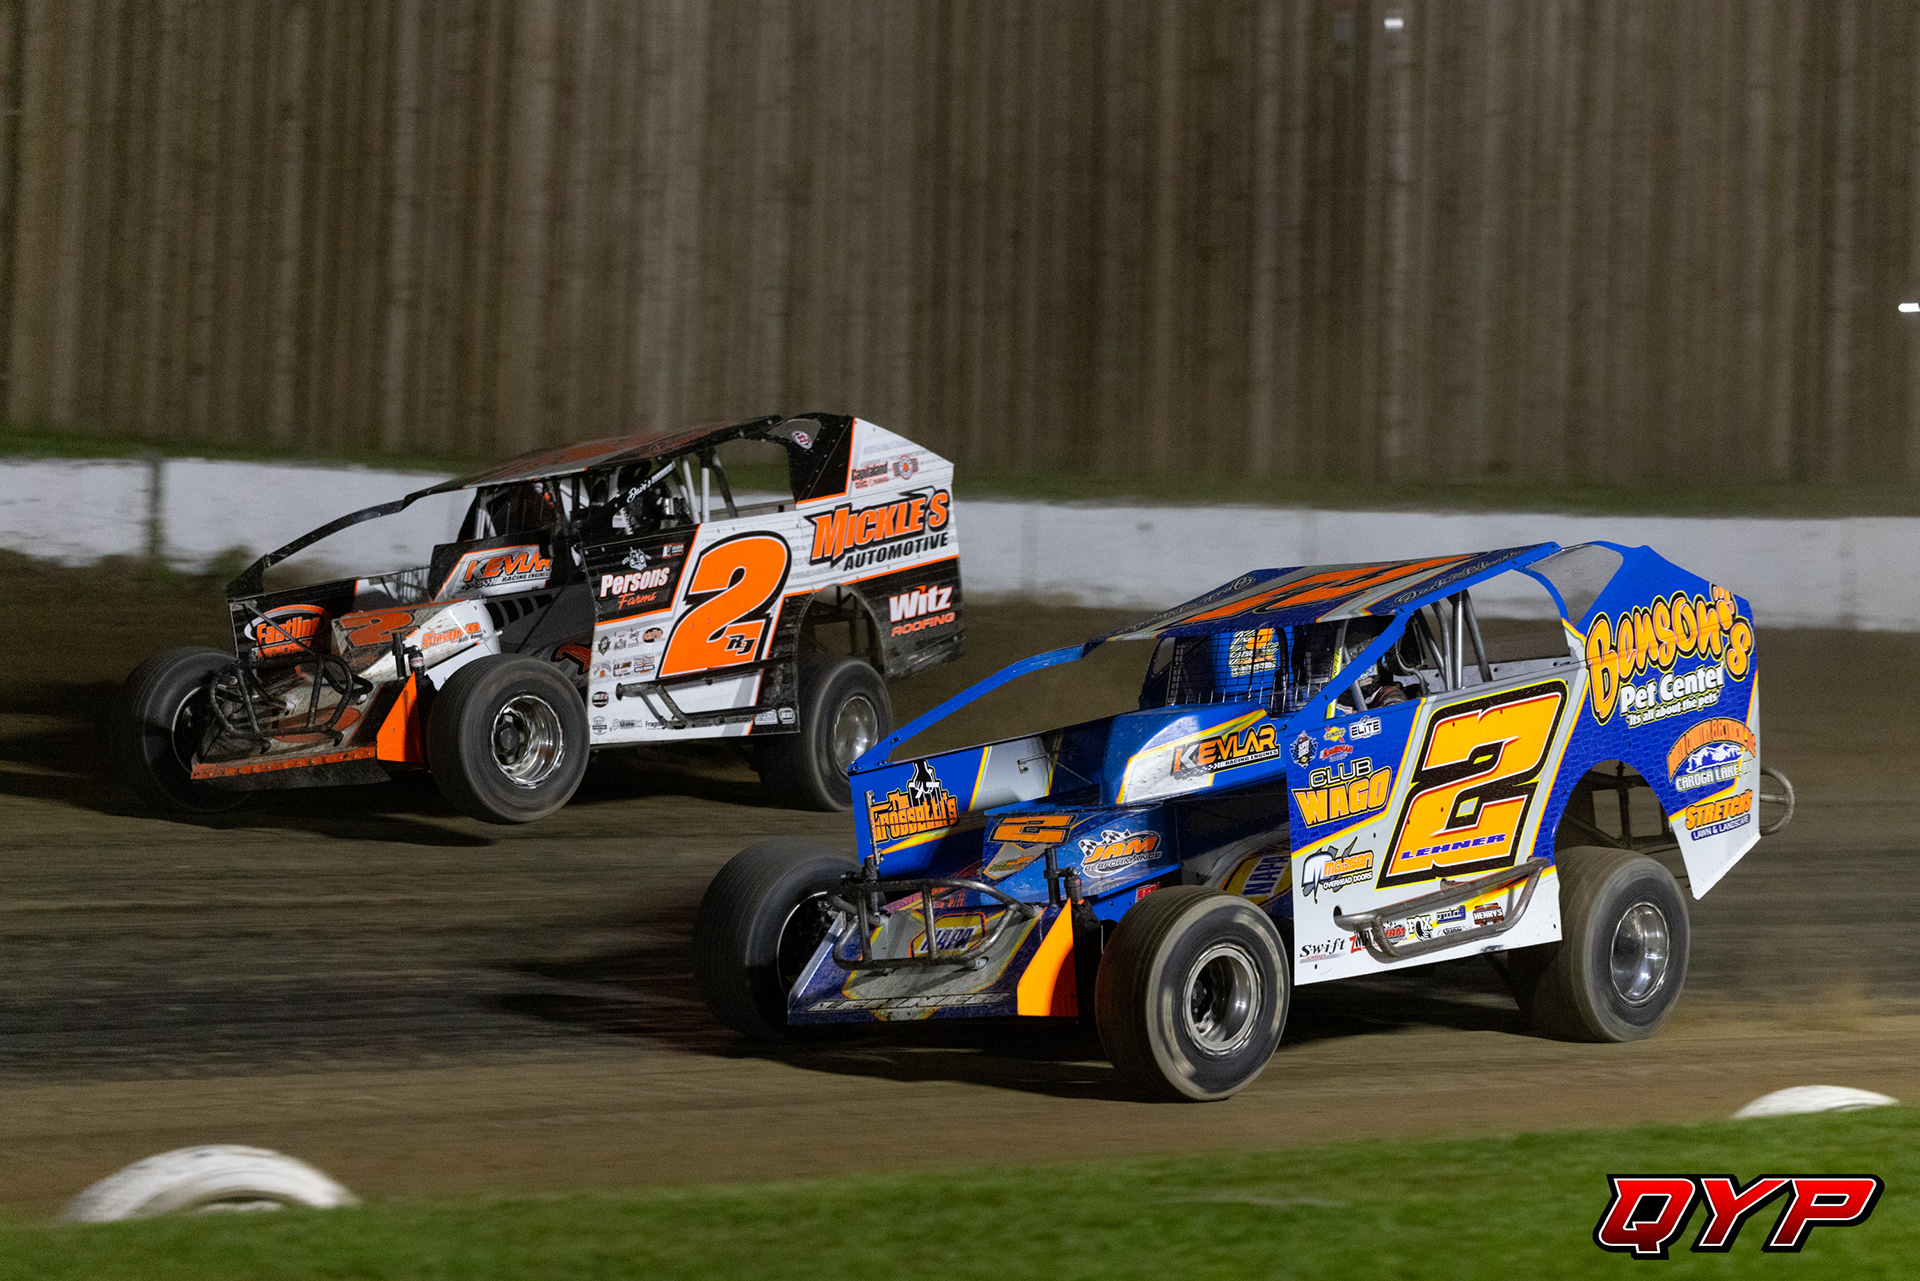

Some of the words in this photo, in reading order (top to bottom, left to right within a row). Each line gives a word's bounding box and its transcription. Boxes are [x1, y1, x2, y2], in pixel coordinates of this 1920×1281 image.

[844, 532, 948, 571] AUTOMOTIVE
[600, 567, 670, 598] Persons
[618, 592, 657, 610] Farms
[657, 532, 790, 678] 2
[889, 585, 953, 623] Witz
[340, 611, 418, 647] 2
[891, 612, 956, 637] ROOFING
[1619, 680, 1657, 714] Pet
[1660, 662, 1724, 702] Center
[1643, 709, 1655, 723] all
[1656, 702, 1682, 719] about
[1682, 697, 1698, 711] the
[1174, 727, 1276, 773] KEVLAR
[1225, 756, 1249, 766] RACING
[1250, 749, 1279, 760] ENGINES
[1310, 758, 1373, 789] CLUB
[1379, 686, 1565, 884] 2
[1675, 769, 1713, 790] CAROGA
[888, 791, 910, 811] The
[1294, 768, 1391, 826] WAGO
[1692, 827, 1712, 840] LAWN
[1712, 824, 1719, 834] &
[1719, 814, 1750, 832] LANDSCAPE
[1084, 835, 1158, 863] JAM
[1401, 832, 1505, 860] LEHNER
[1083, 851, 1163, 872] PERFORMANCE
[1242, 856, 1291, 895] NAPA
[1323, 876, 1352, 889] OVERHEAD
[1353, 871, 1373, 883] DOORS
[1407, 914, 1433, 940] FOX
